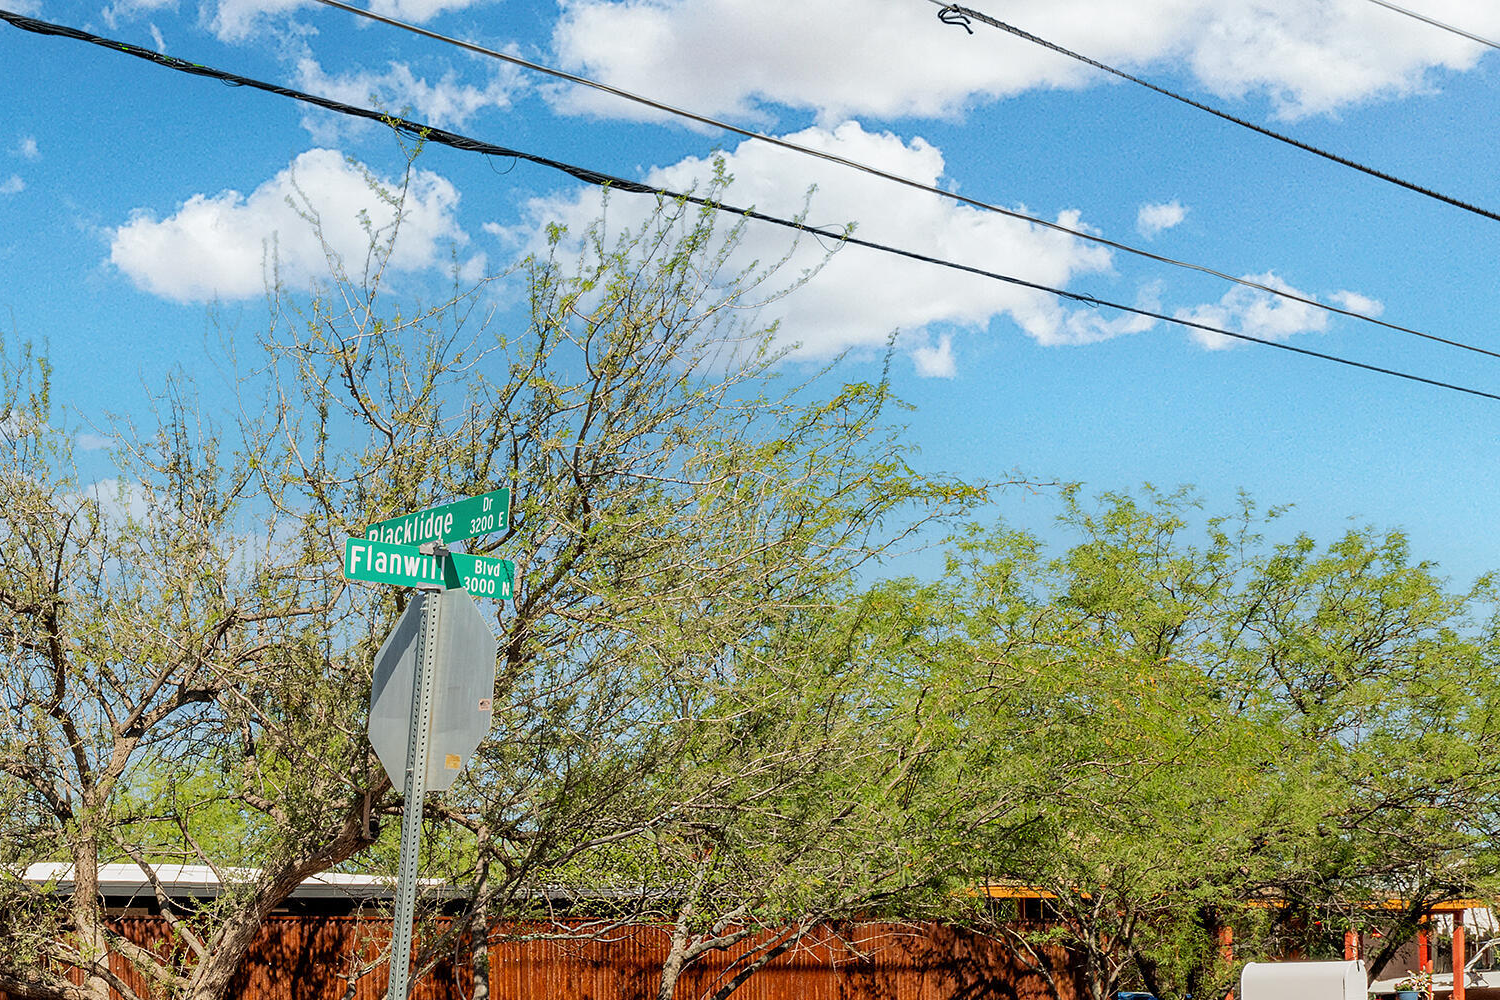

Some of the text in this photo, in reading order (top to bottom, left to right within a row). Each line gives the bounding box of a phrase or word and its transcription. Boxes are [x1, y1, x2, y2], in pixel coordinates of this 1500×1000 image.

[482, 497, 493, 512] Dr
[469, 511, 505, 534] 3200 E
[474, 559, 500, 577] Blvd
[463, 576, 510, 597] 3000 N
